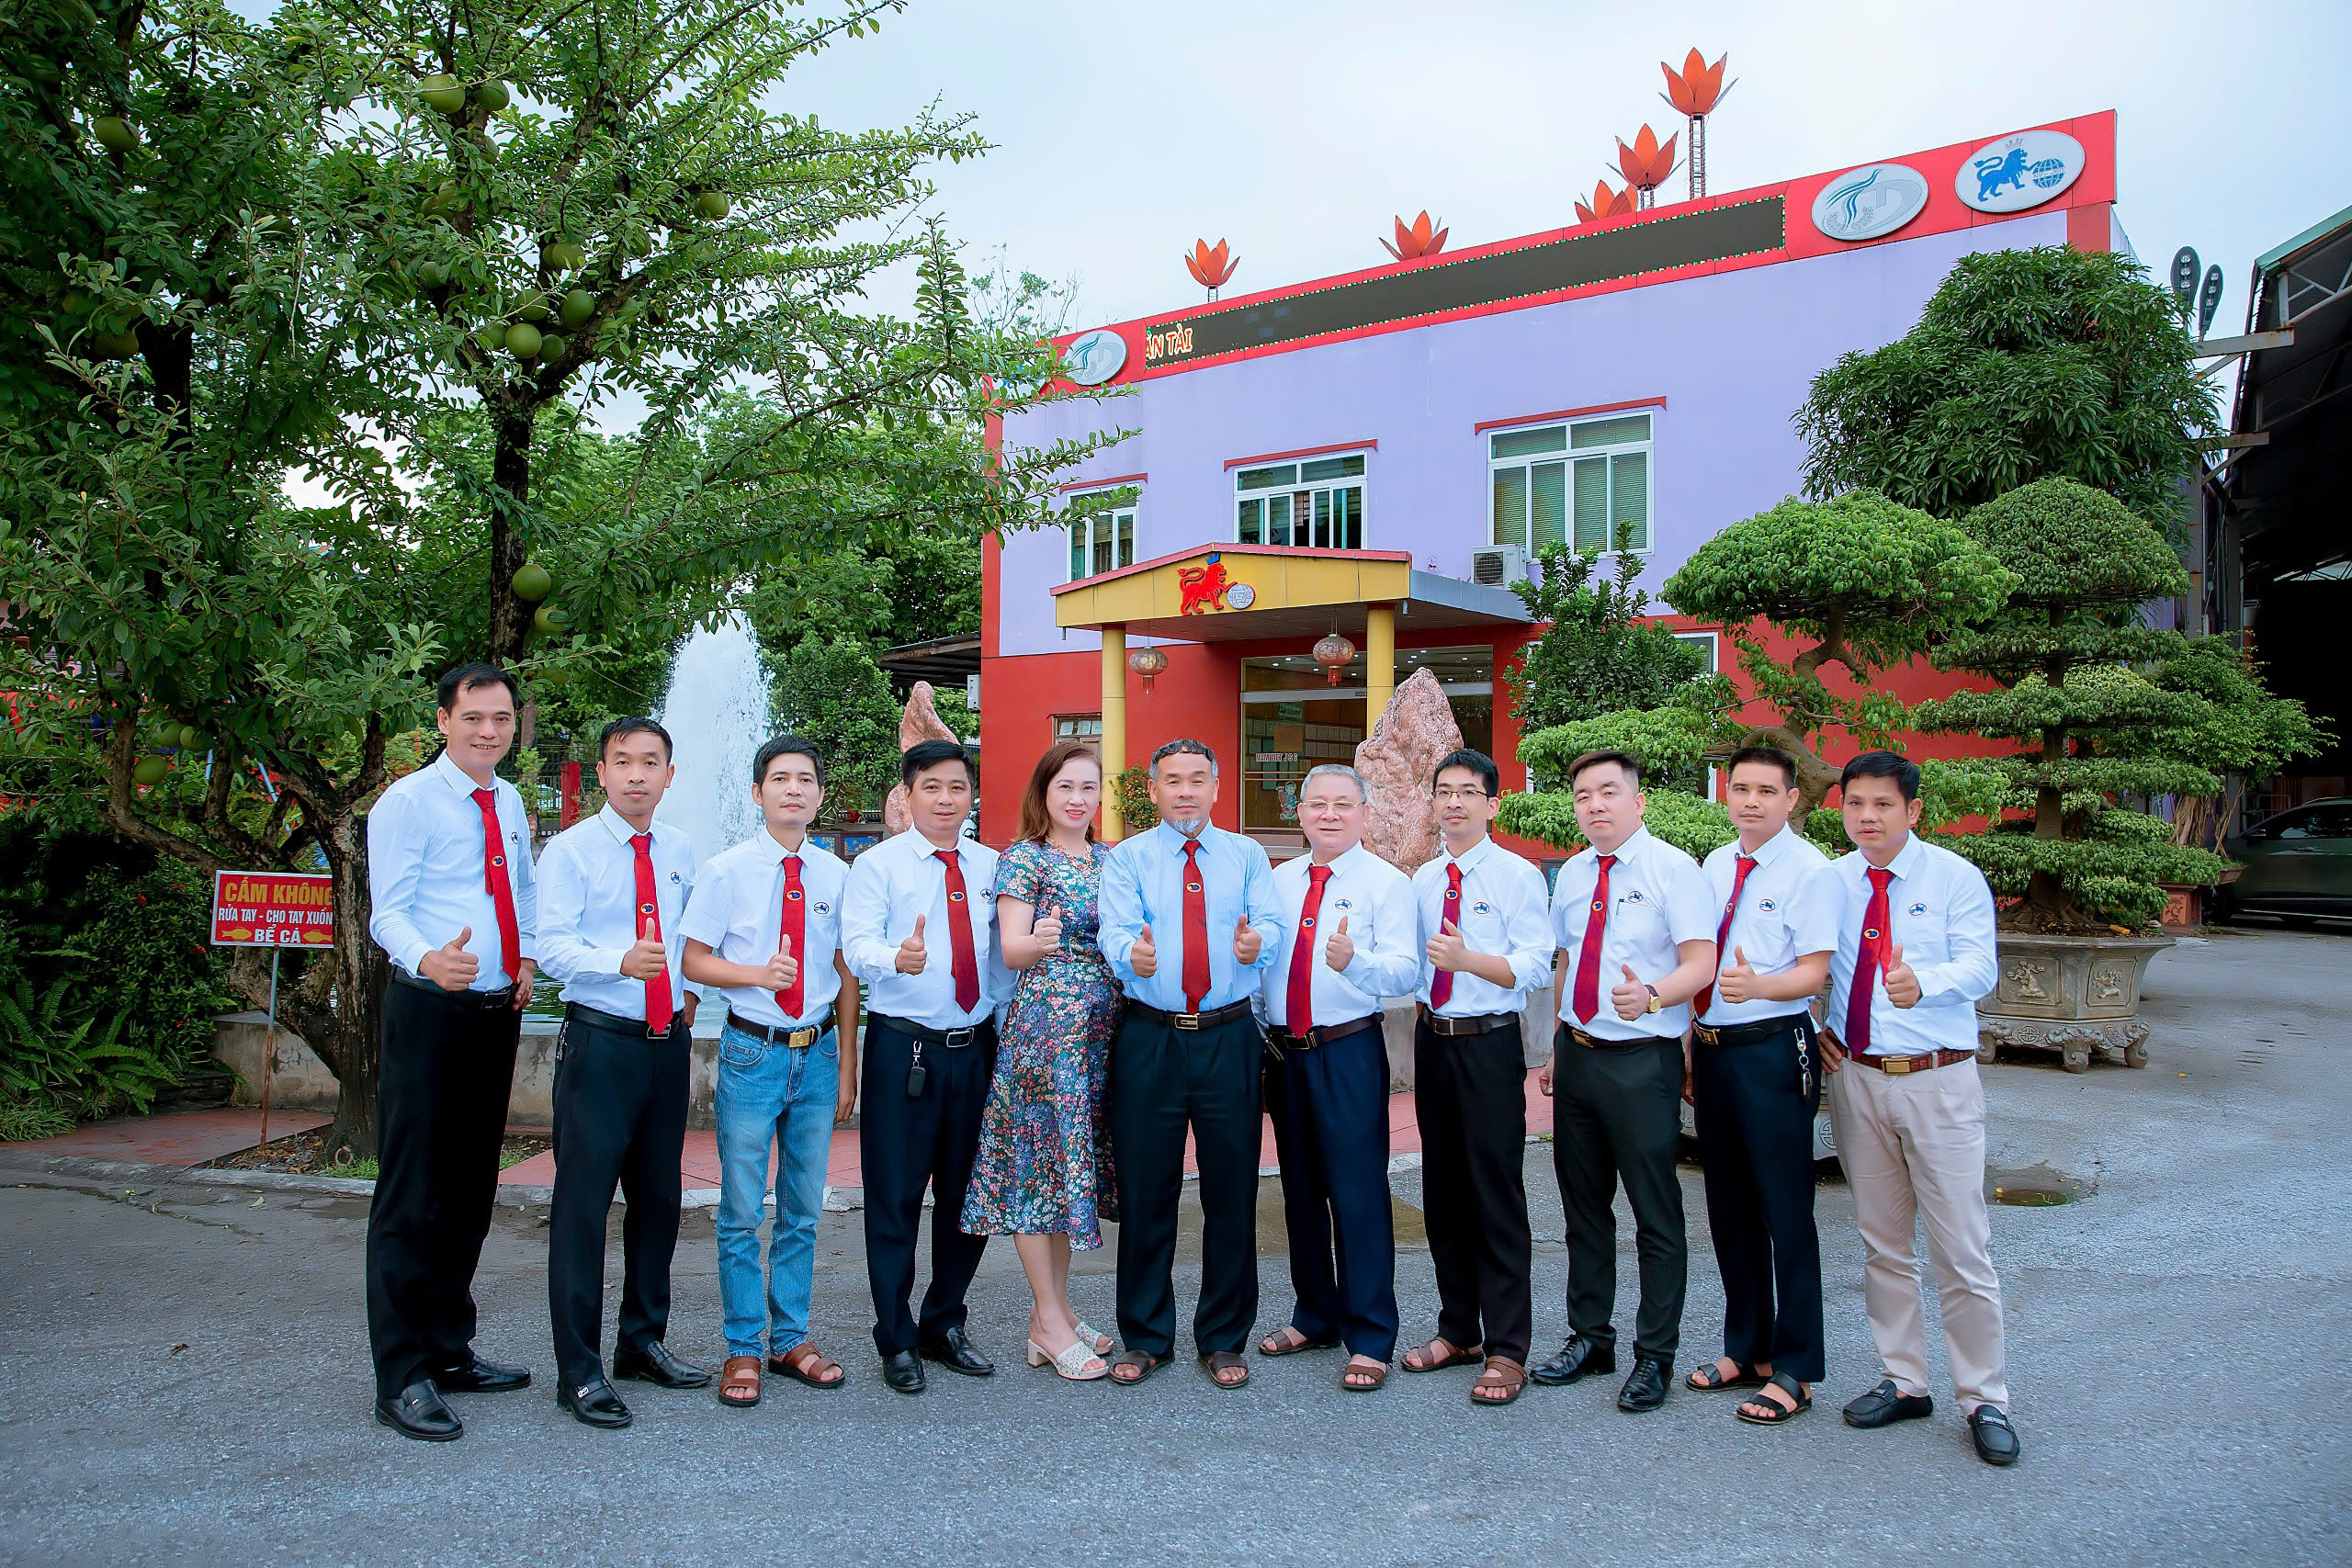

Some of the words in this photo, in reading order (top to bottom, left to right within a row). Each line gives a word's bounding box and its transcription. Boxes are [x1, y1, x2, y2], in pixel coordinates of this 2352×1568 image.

[1256, 753, 1270, 761] NAM
[225, 876, 267, 902] CẤM
[218, 904, 238, 920] RỬA
[242, 908, 257, 921] TAY
[266, 909, 286, 923] CHO
[288, 910, 304, 923] TAY
[306, 907, 333, 924] XUỐN
[254, 923, 277, 942] BỂ
[280, 928, 301, 943] CÁ
